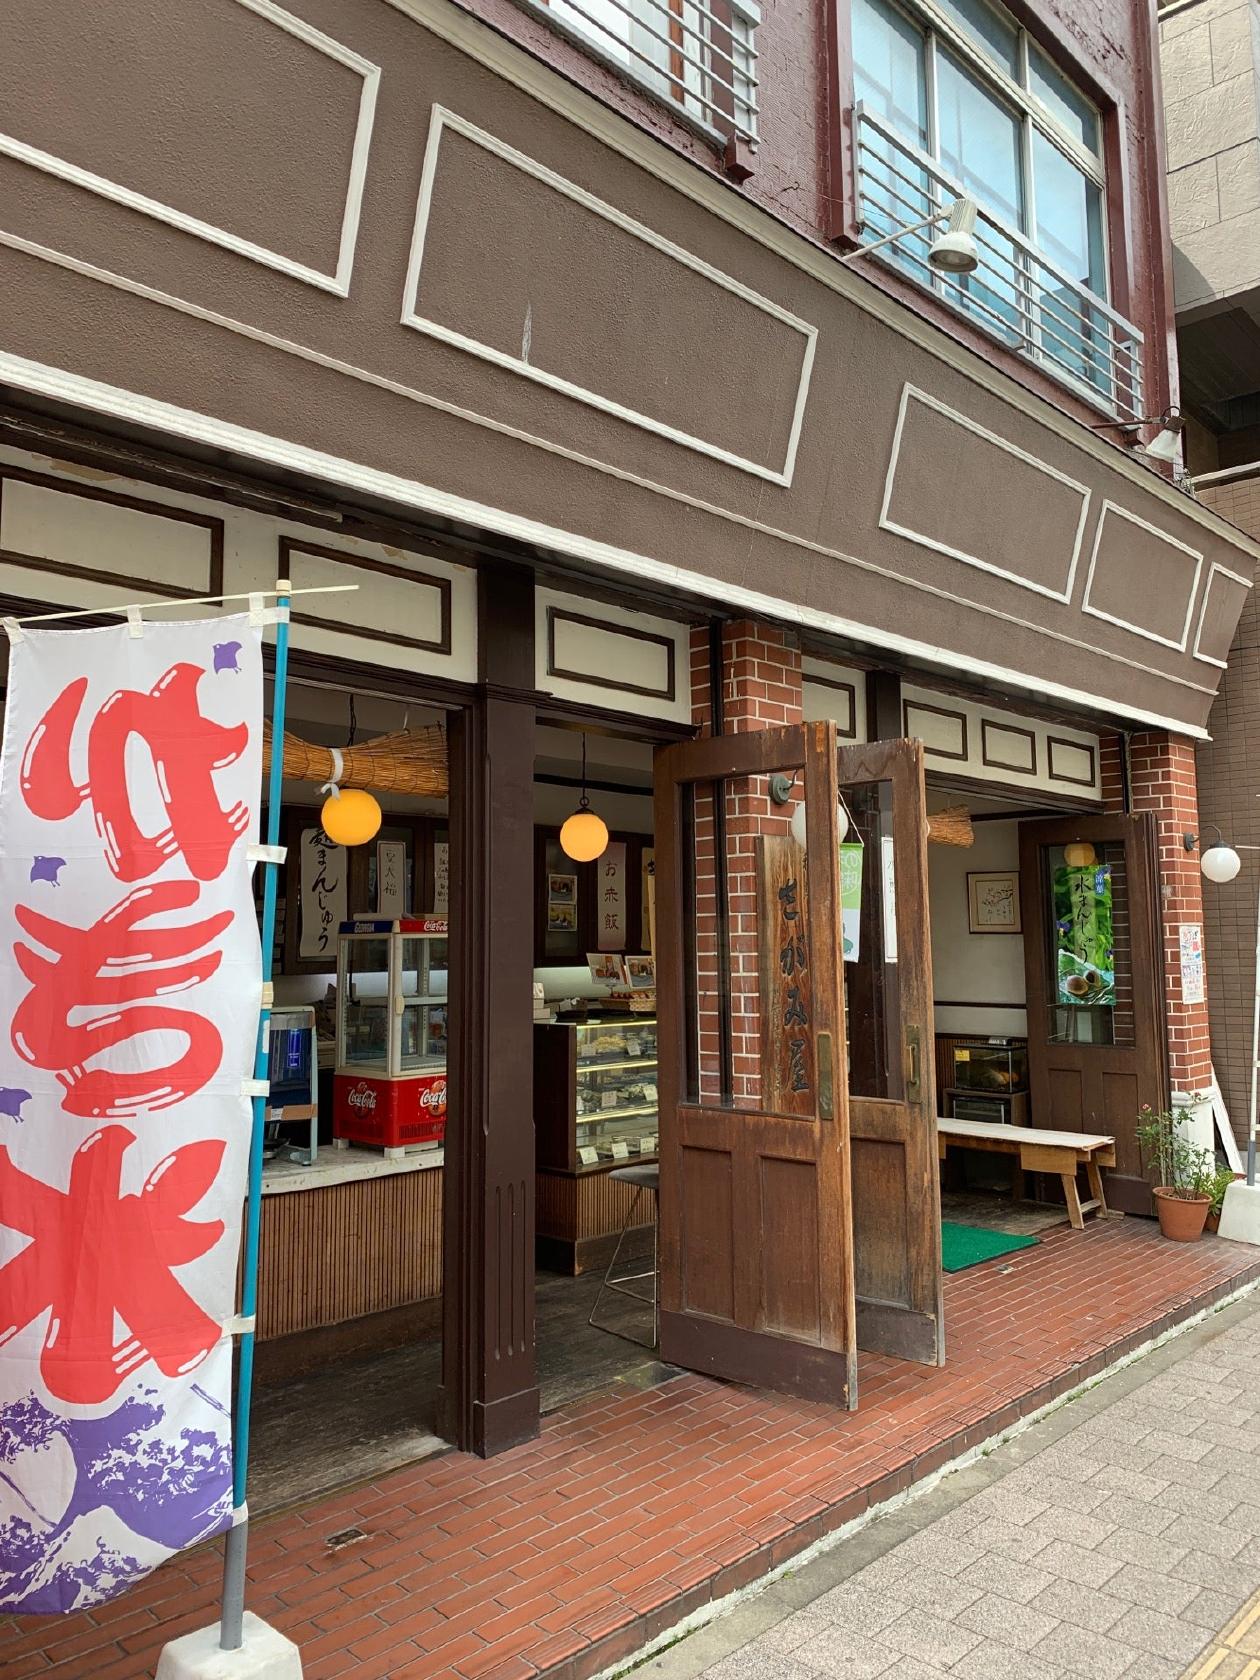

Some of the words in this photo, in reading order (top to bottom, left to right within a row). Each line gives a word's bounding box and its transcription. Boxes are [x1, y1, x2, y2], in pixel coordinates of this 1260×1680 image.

[604, 861, 620, 931] お赤飯
[348, 1088, 377, 1109] Coca-Cola
